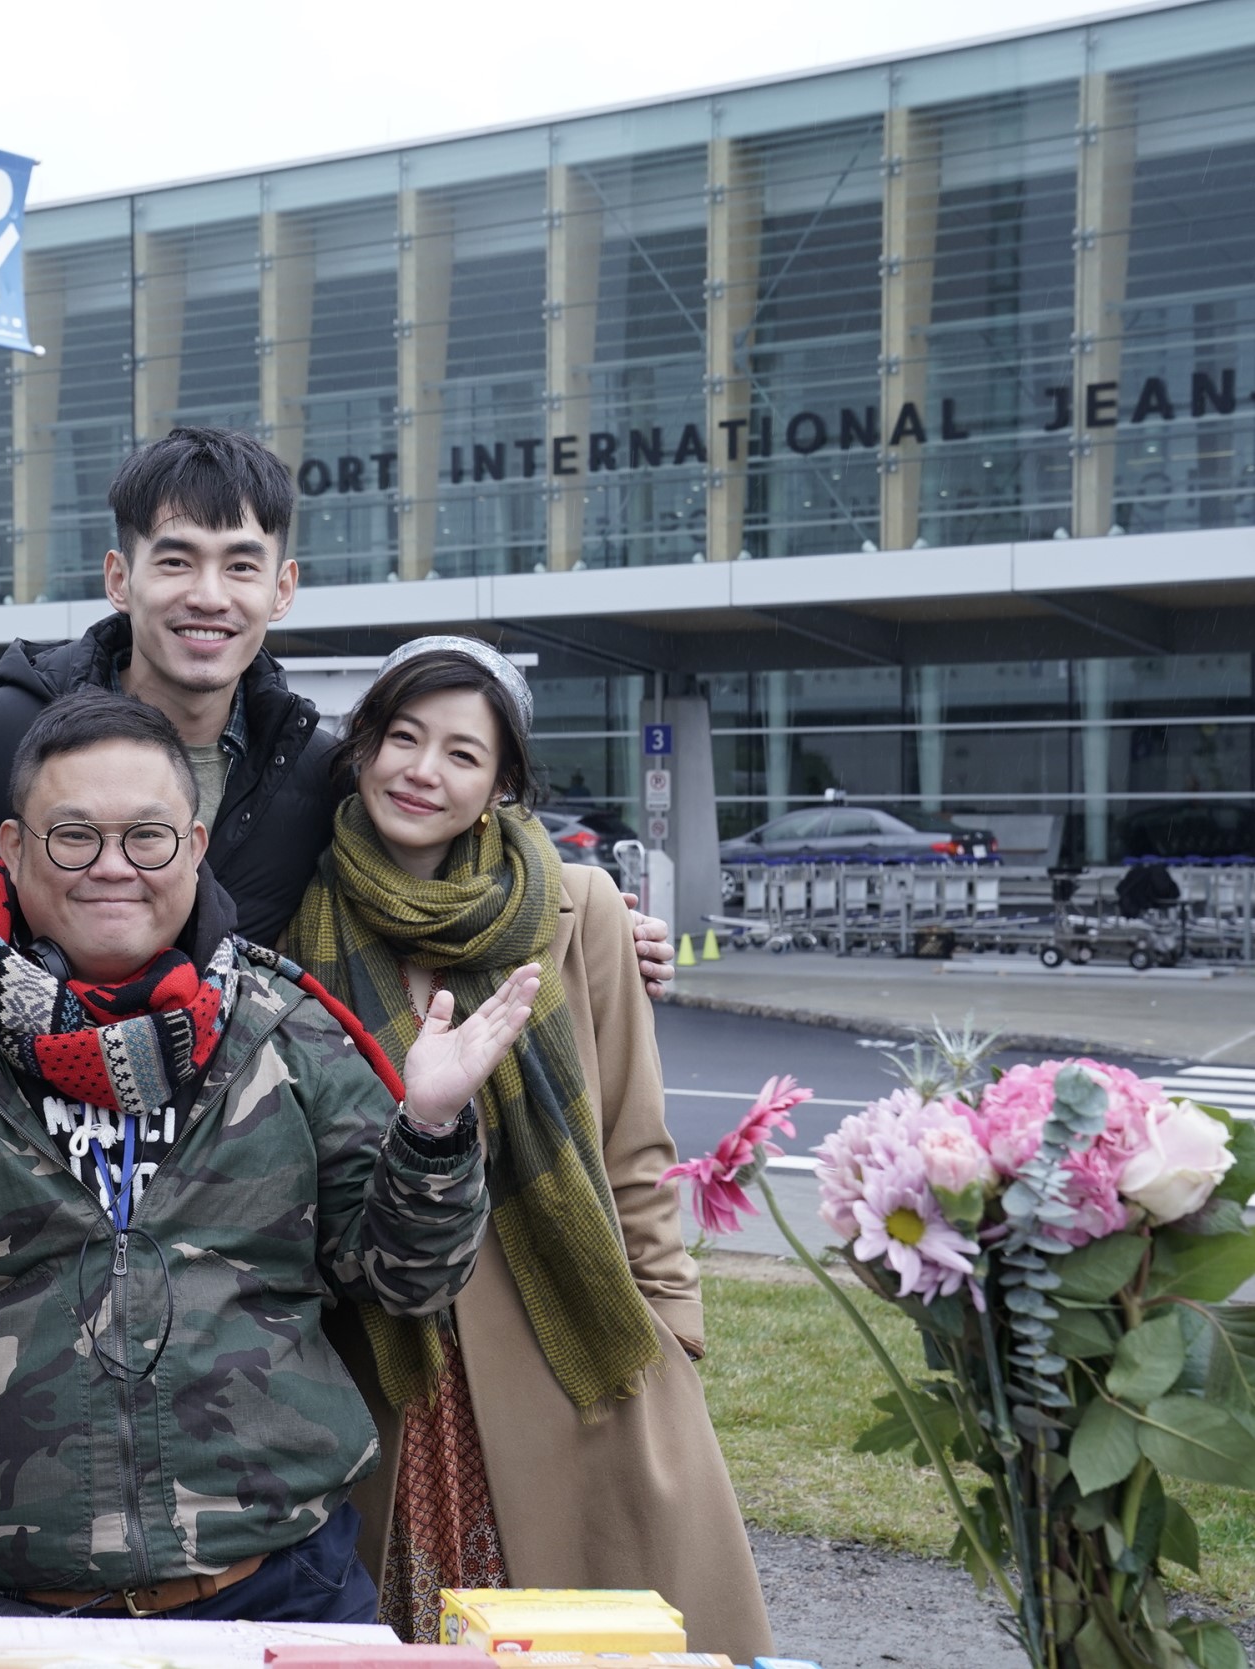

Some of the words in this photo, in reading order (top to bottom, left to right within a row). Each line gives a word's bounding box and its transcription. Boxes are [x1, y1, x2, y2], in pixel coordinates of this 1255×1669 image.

[298, 453, 398, 496] ORT
[451, 398, 969, 484] INTERNATIONAL
[652, 729, 664, 750] 3
